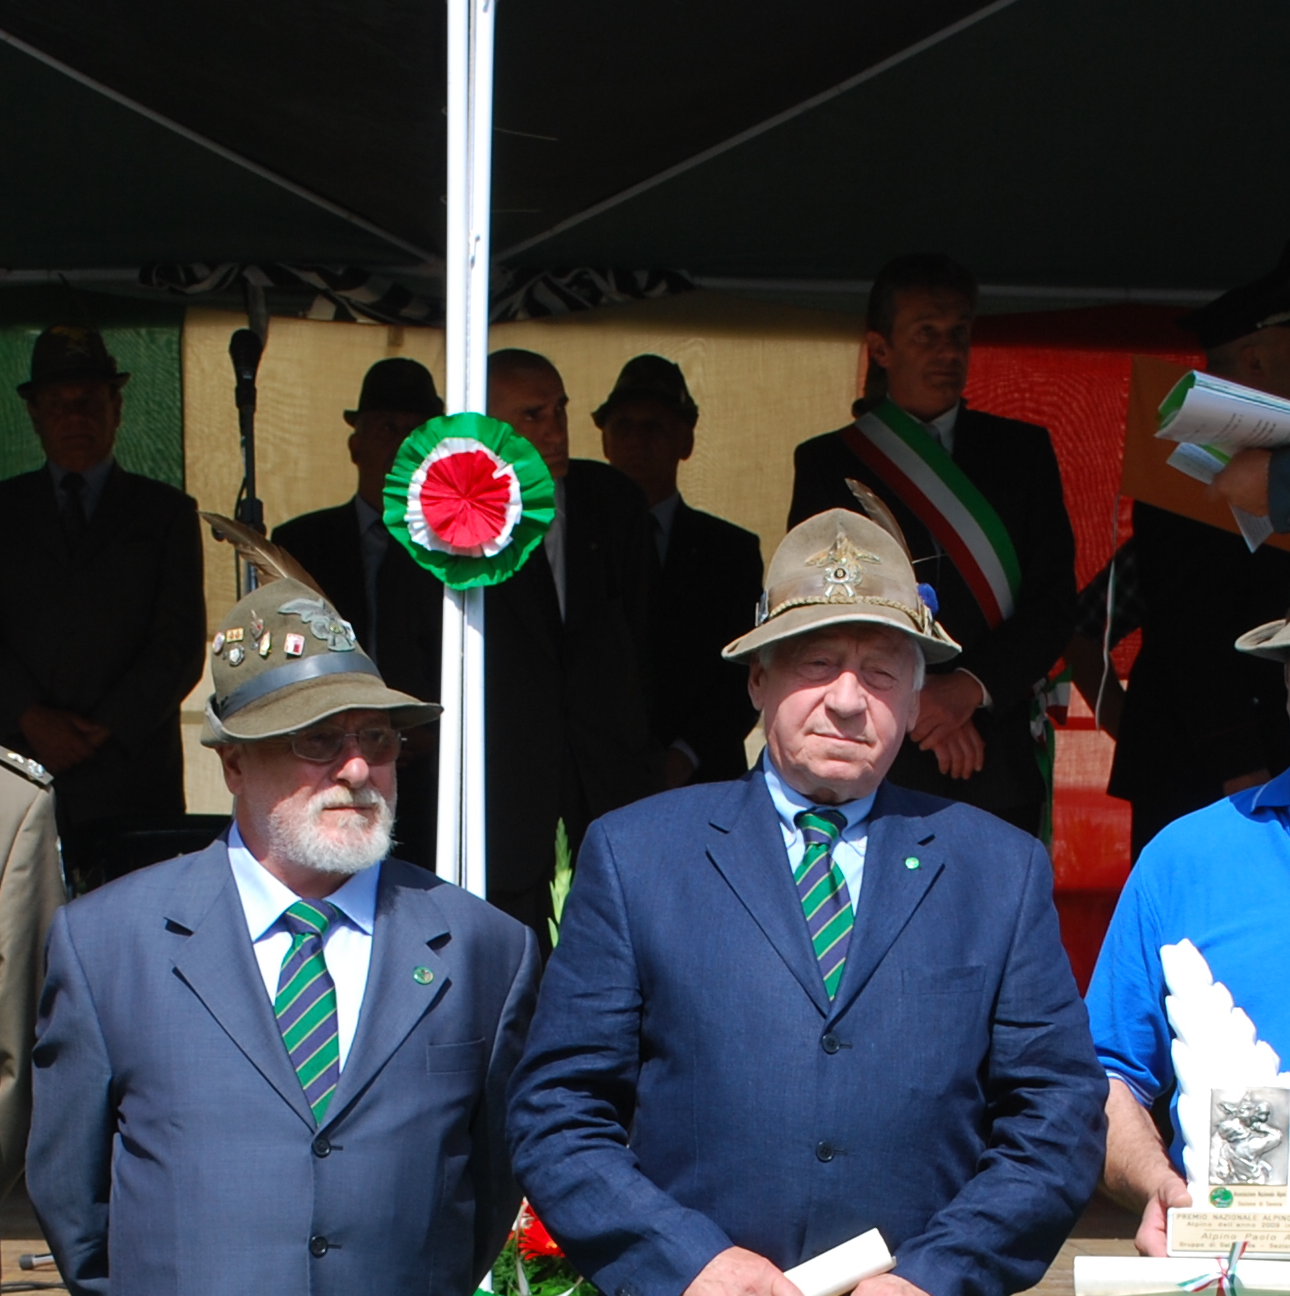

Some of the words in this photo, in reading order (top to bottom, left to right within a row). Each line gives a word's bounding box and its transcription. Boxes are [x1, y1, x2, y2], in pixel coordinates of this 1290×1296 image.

[1176, 1213, 1208, 1221] PREMIO
[1200, 1232, 1237, 1241] Alpino
[1244, 1233, 1277, 1241] Paolo
[1179, 1241, 1205, 1249] Gruppo
